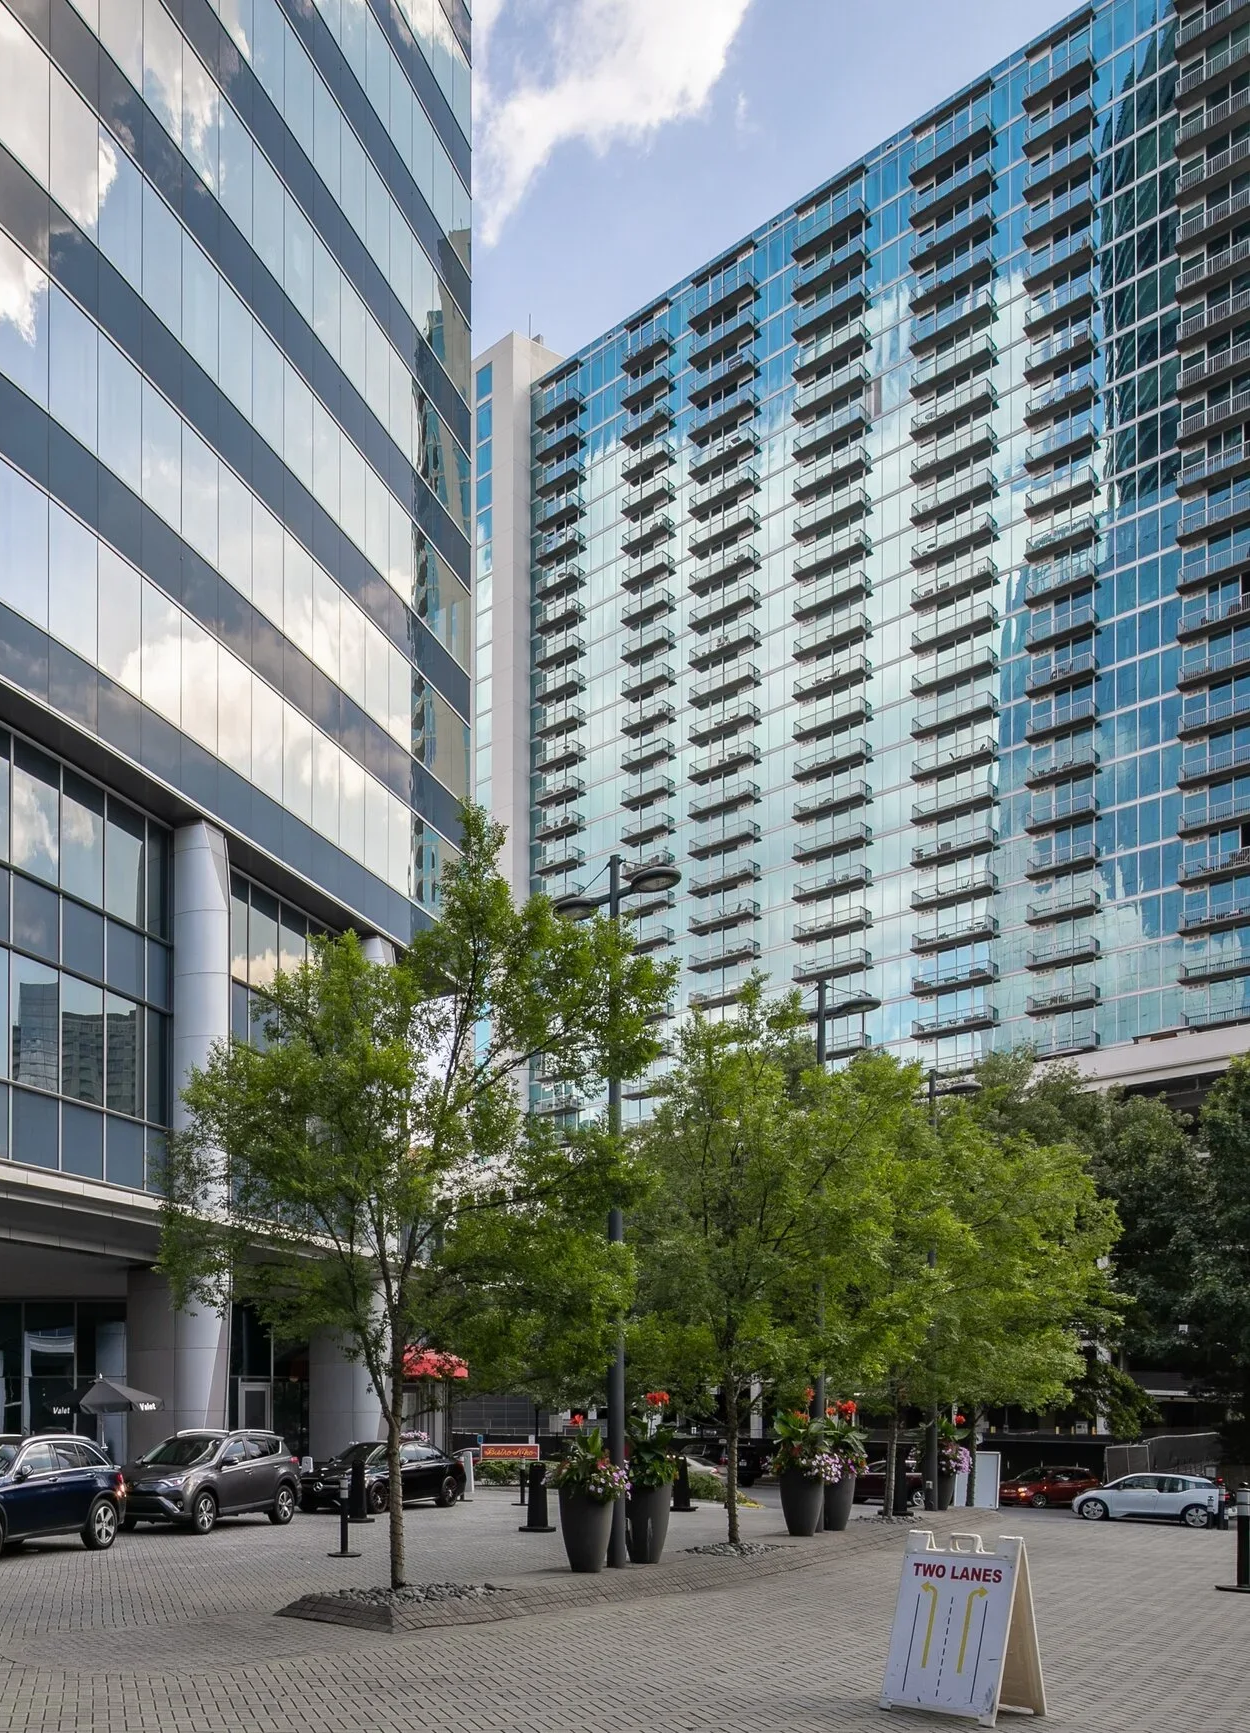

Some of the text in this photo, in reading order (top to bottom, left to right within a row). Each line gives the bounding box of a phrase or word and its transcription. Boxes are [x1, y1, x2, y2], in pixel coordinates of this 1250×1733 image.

[52, 1406, 70, 1415] Valet
[139, 1402, 157, 1411] Valet
[913, 1562, 1003, 1584] TWO LANES
